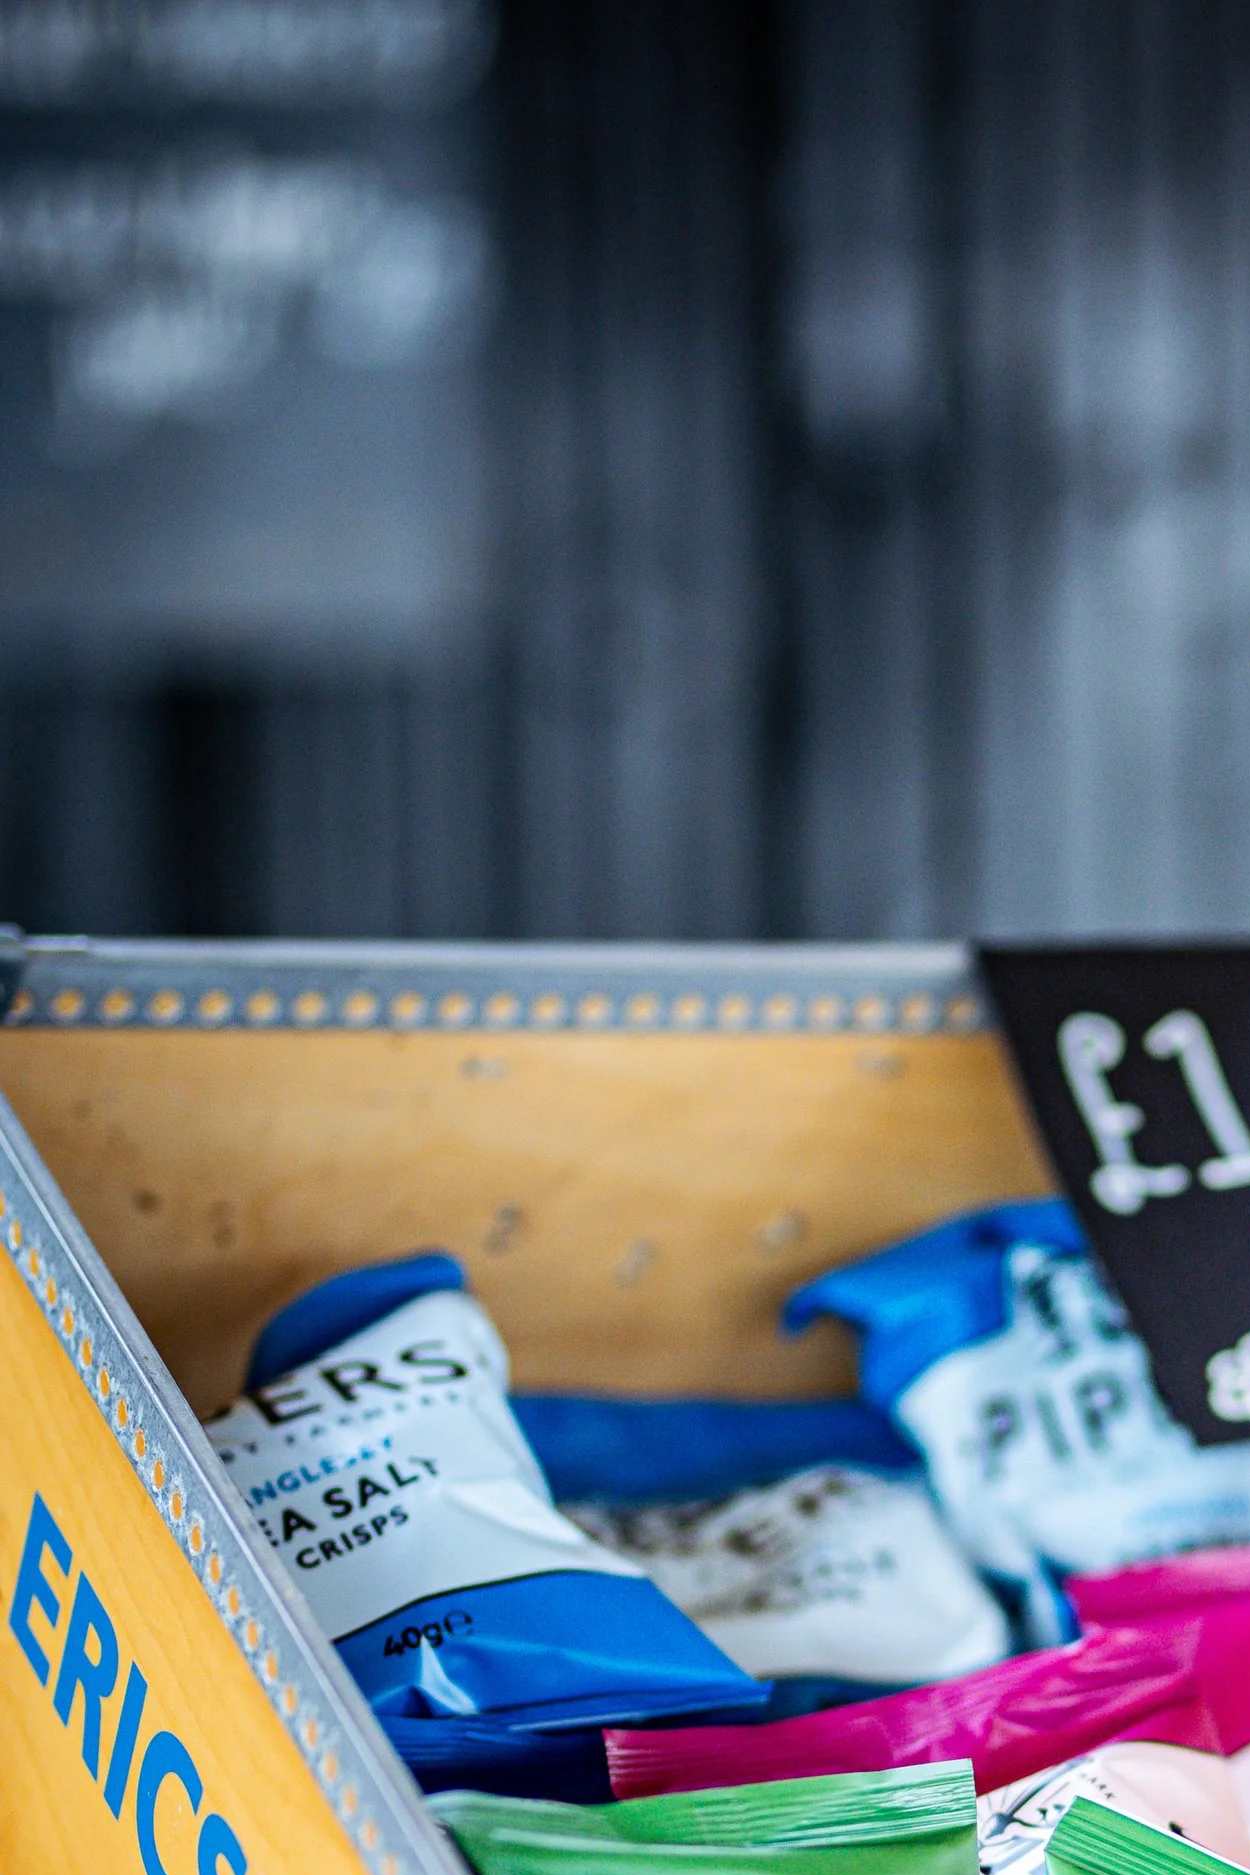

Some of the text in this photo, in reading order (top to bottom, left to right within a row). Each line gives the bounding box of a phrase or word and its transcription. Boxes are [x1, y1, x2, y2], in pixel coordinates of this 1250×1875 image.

[203, 1339, 468, 1428] ERS
[980, 1370, 1130, 1480] PIP
[296, 1505, 409, 1570] CRISPS
